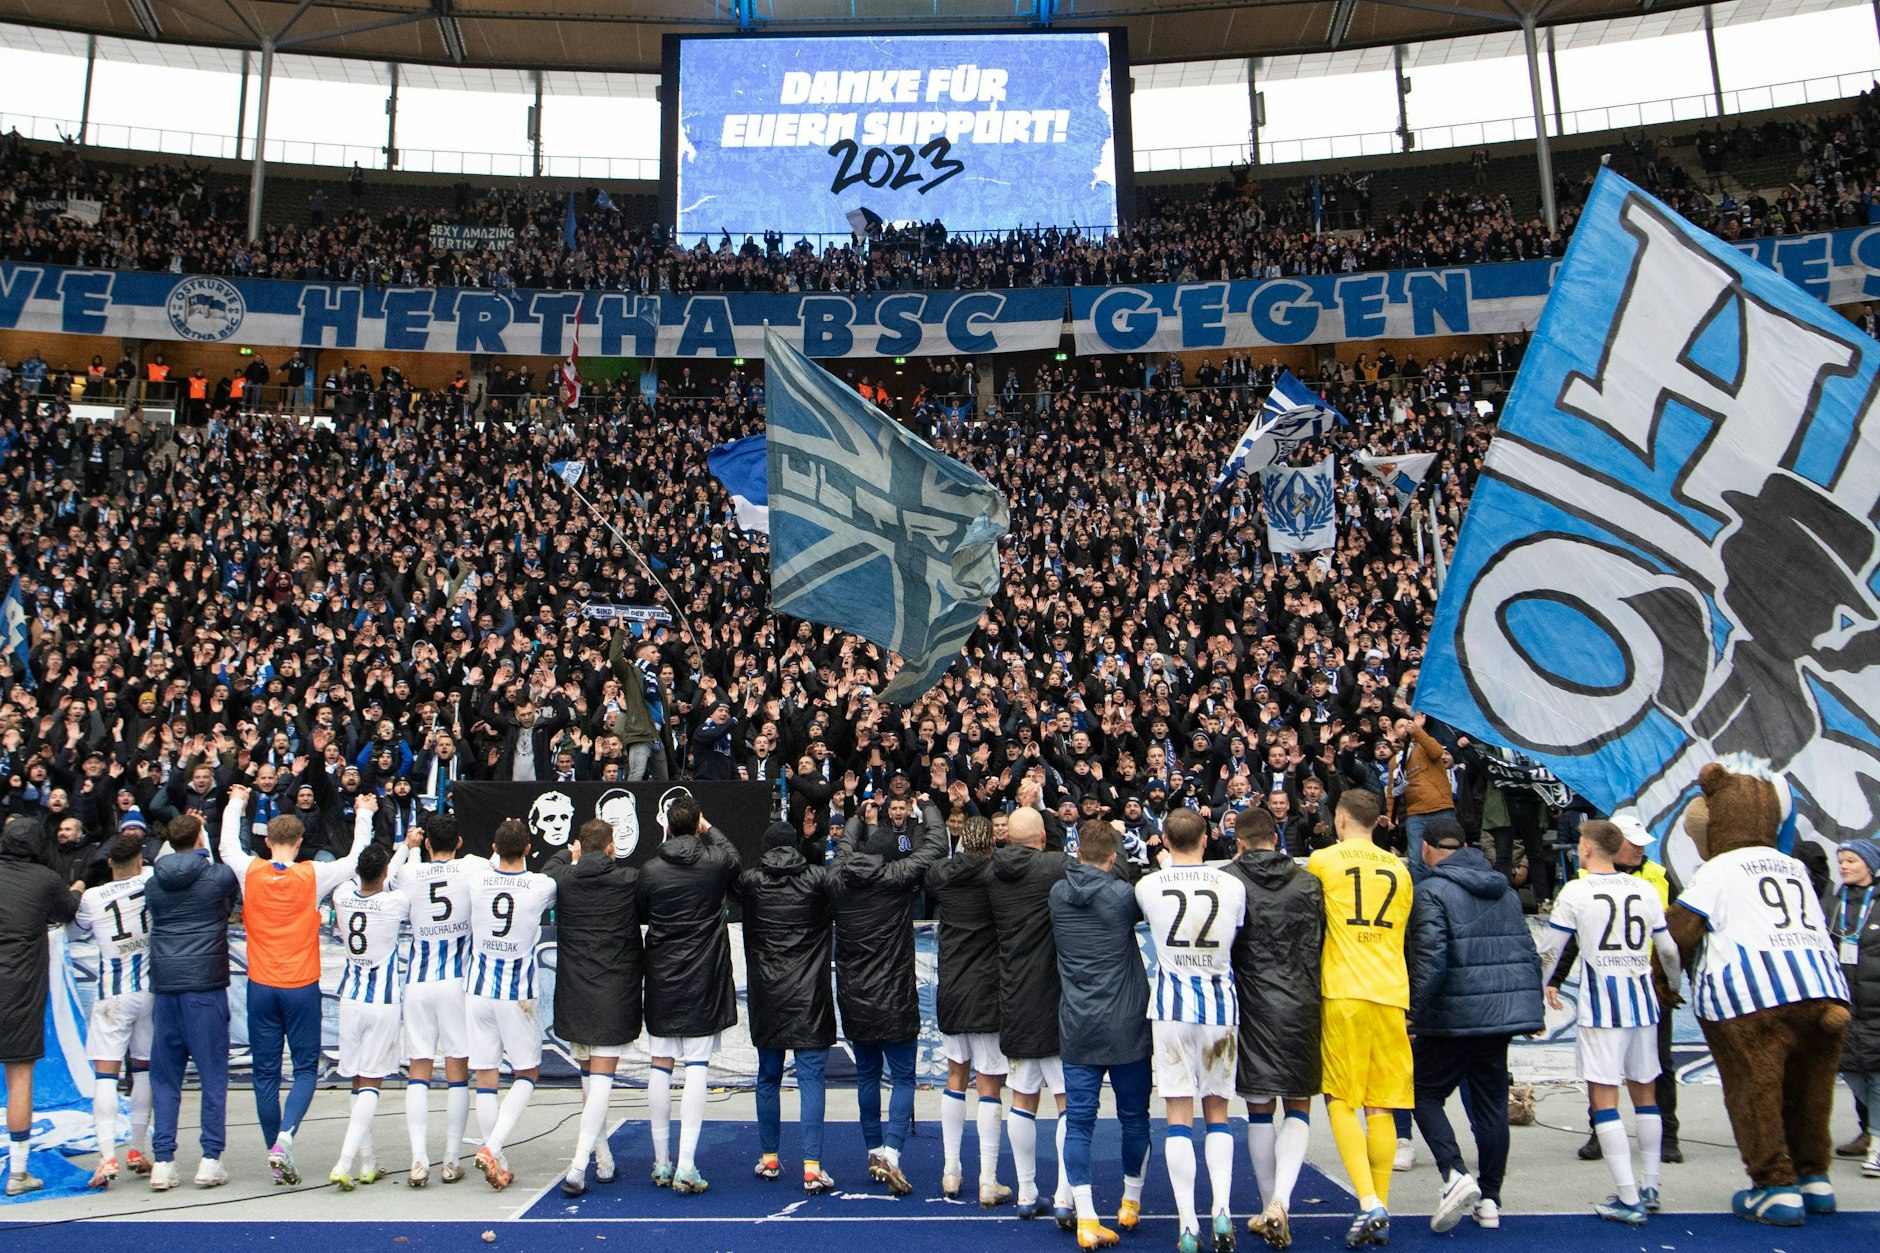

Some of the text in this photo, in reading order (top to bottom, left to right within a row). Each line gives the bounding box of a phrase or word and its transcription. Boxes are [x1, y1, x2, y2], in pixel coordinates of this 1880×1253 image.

[780, 64, 1009, 104] DANKE FÜR
[862, 109, 1071, 145] SUPPORT!
[827, 136, 965, 195] 2023
[429, 223, 515, 239] SEXY AMAZING
[175, 280, 238, 304] OSTKURVE
[172, 313, 239, 340] HERTHA BSC
[298, 284, 738, 357] HERTHA
[798, 290, 1006, 357] BSC
[1090, 268, 1473, 350] GEGEN
[416, 862, 461, 878] HERTHA BSC
[483, 877, 531, 889] HERTHA BSC
[1160, 871, 1222, 884] HERTHA BSC
[1741, 858, 1789, 877] HERTHA
[99, 882, 131, 899] HERTHA
[430, 880, 453, 922] 5
[1345, 866, 1397, 930] 12
[104, 890, 148, 942] 17
[420, 920, 469, 937] BOUCHALAKIS
[492, 892, 515, 938] 9
[1161, 889, 1220, 948] 22
[1592, 893, 1646, 951] 26
[348, 911, 368, 956] 8
[483, 938, 518, 952] PREVLJAK
[1174, 954, 1213, 967] WINKLER
